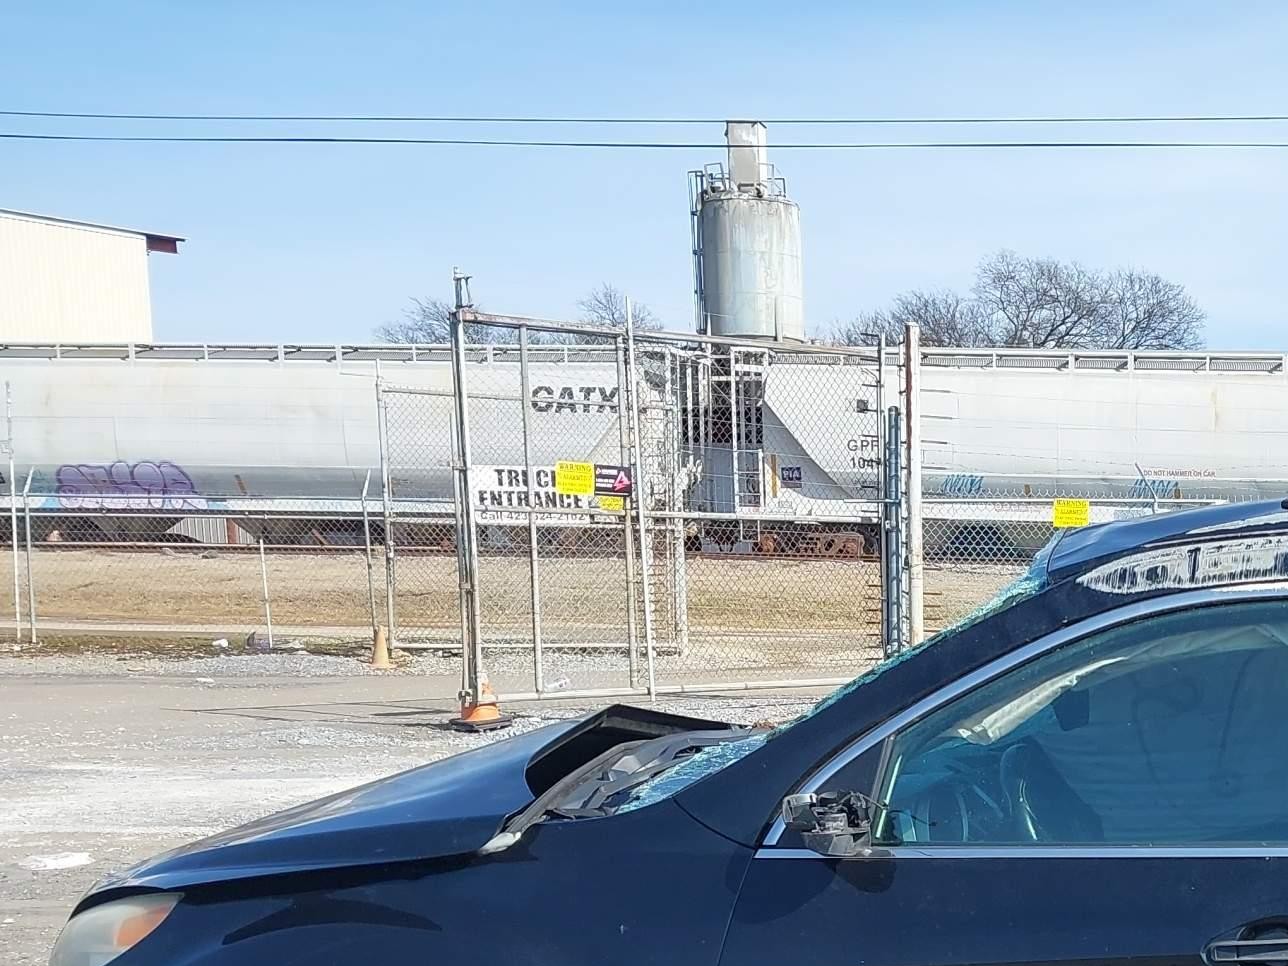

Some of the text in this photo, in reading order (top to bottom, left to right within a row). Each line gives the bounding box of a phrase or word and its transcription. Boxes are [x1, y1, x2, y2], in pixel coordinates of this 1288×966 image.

[531, 386, 618, 413] GATX
[847, 439, 880, 452] GPF
[558, 463, 592, 473] WARNING
[494, 469, 557, 488] TRUC
[478, 489, 584, 509] ENTRANCE
[480, 511, 503, 521] Call
